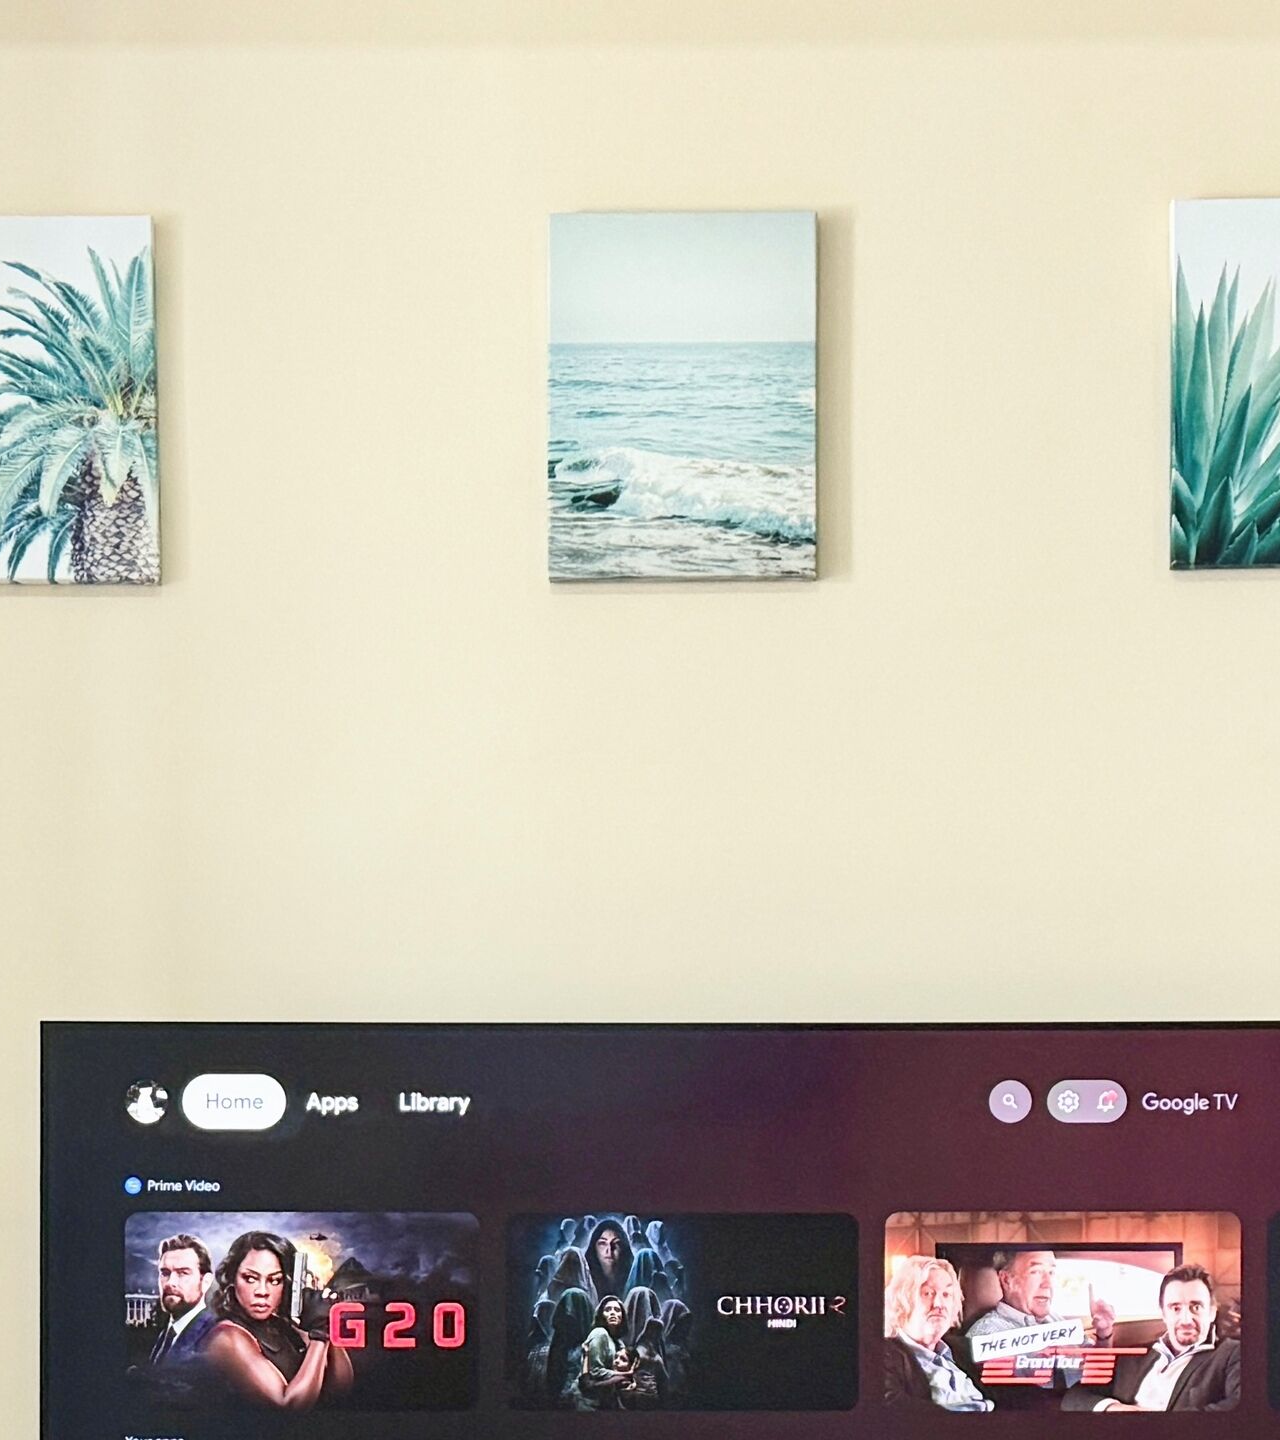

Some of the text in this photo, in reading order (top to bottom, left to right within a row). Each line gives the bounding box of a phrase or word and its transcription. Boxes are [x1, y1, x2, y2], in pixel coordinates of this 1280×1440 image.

[205, 1092, 264, 1110] Home
[306, 1092, 359, 1115] Apps
[398, 1091, 471, 1116] Library
[1141, 1091, 1239, 1115] Google TV
[147, 1179, 221, 1192] Prime Video
[716, 1295, 826, 1316] CHHORII
[767, 1318, 797, 1329] HINDI
[980, 1325, 1077, 1353] THE NOT VERY
